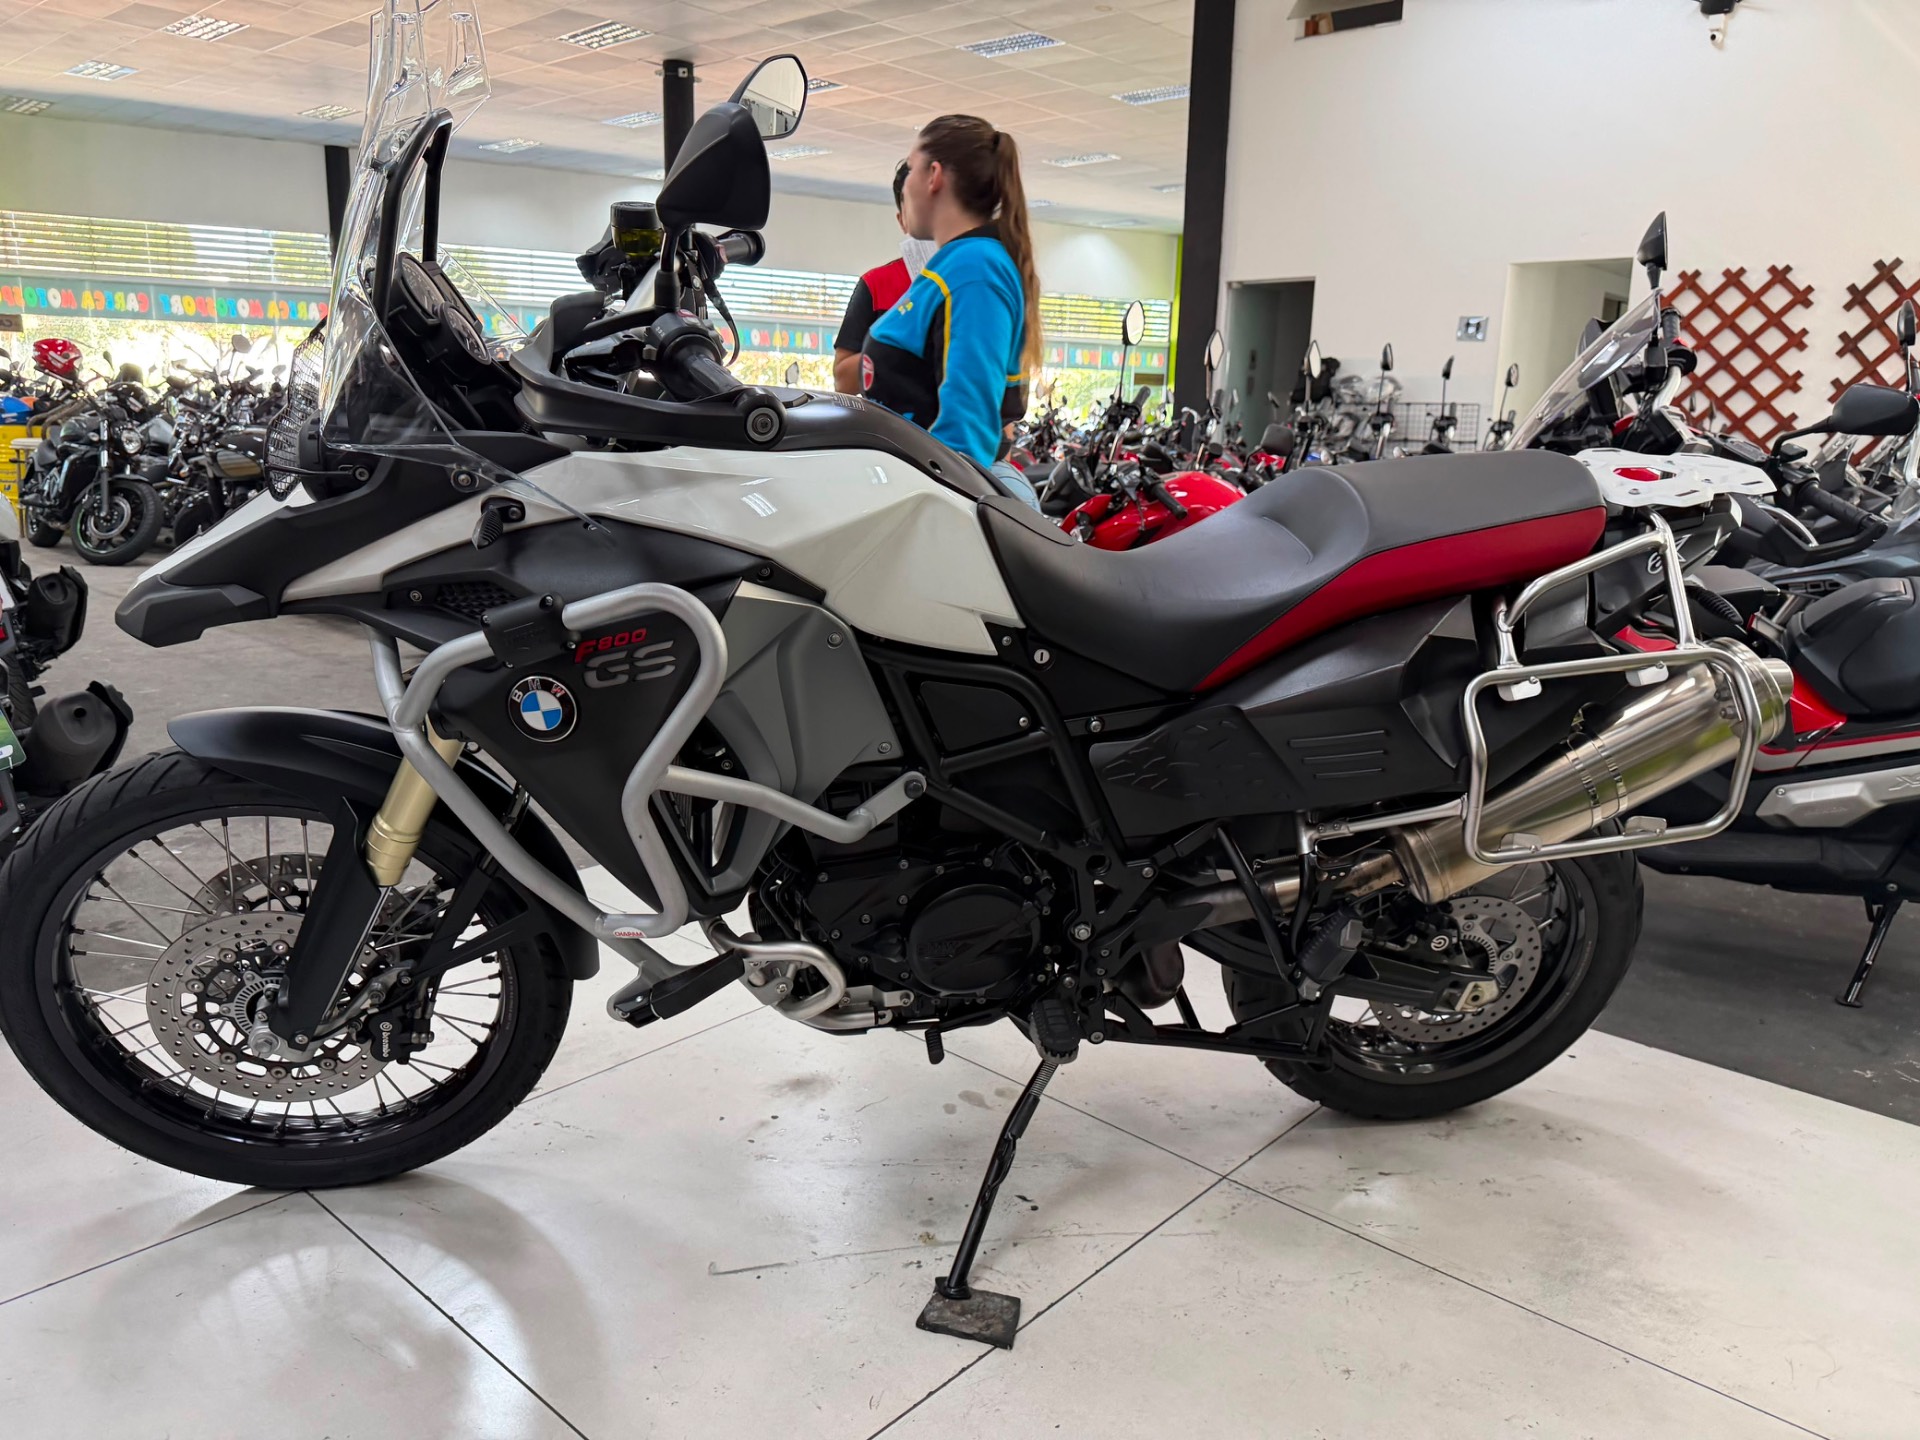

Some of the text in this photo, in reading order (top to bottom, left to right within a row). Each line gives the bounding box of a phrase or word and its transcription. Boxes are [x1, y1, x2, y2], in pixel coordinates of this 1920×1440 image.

[574, 627, 647, 664] F800
[583, 640, 677, 689] GS
[511, 677, 565, 703] BMW
[382, 1031, 391, 1058] brembo
